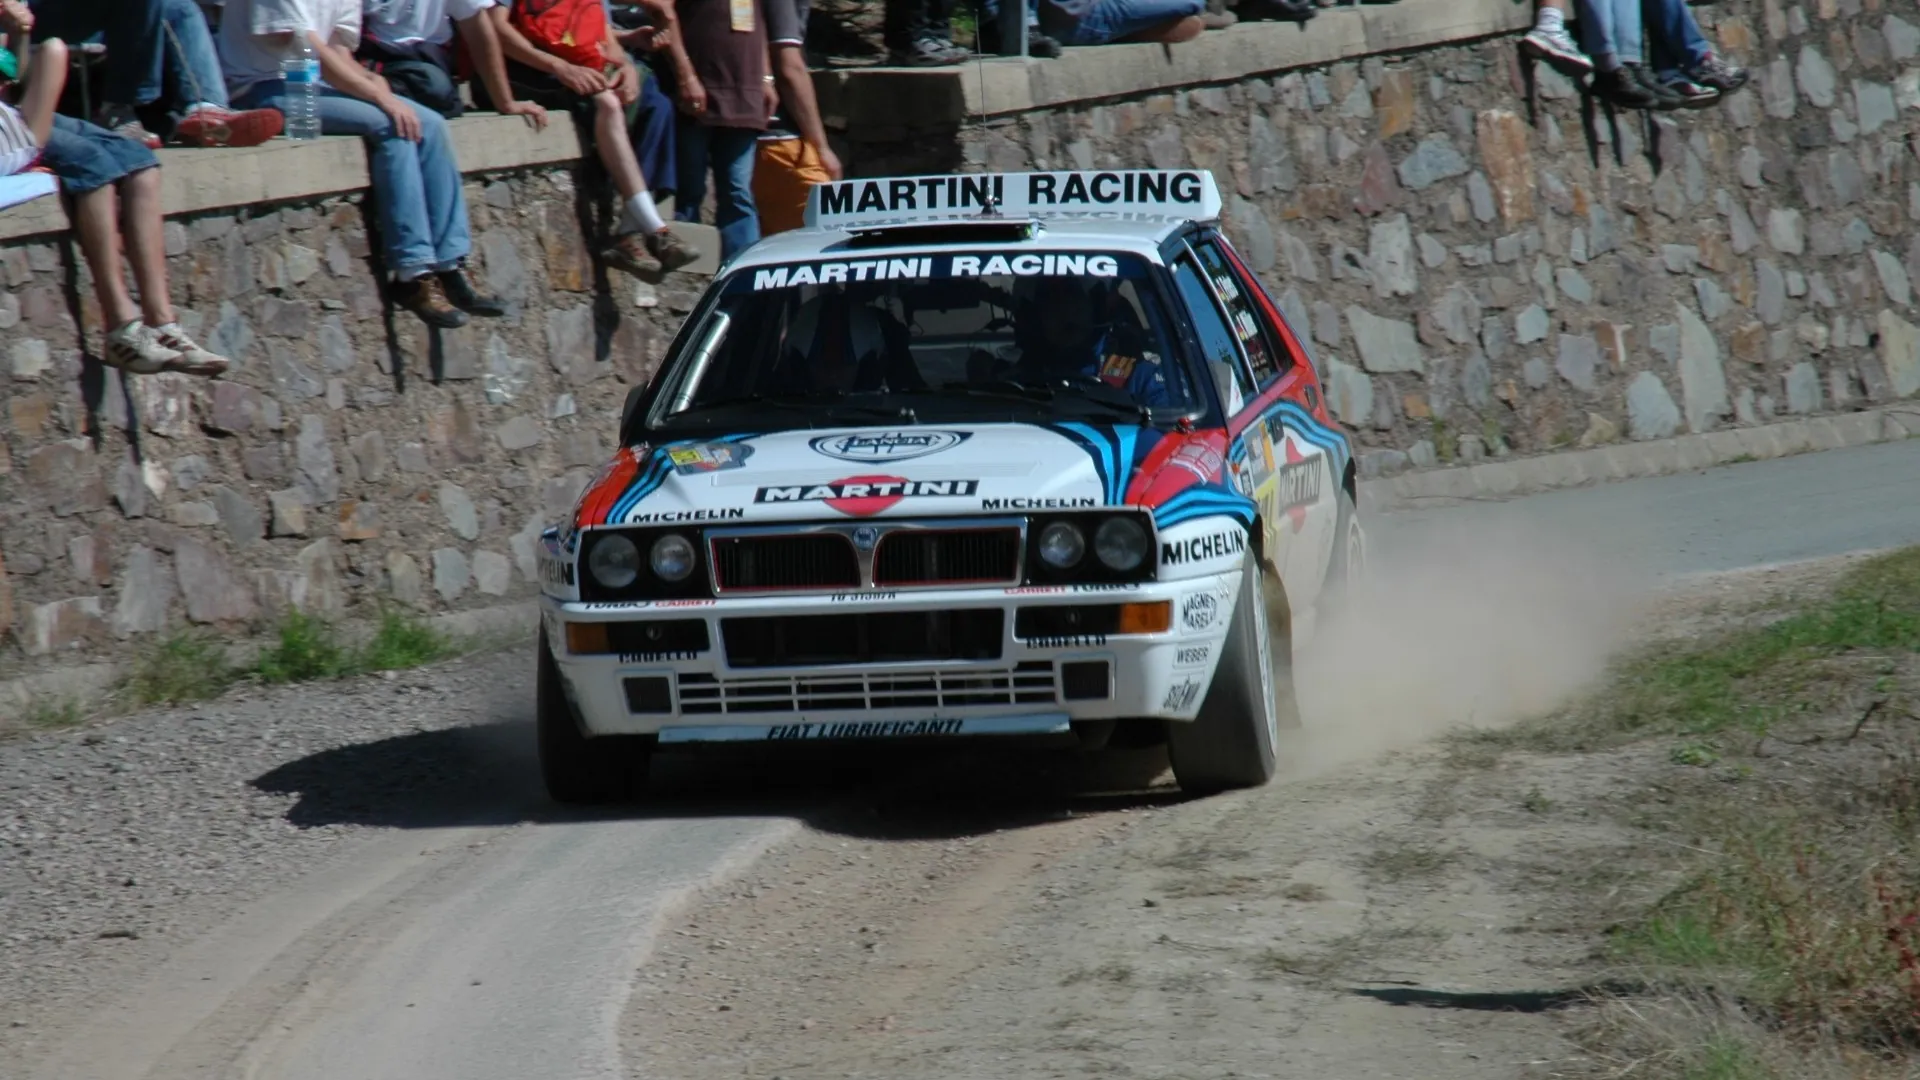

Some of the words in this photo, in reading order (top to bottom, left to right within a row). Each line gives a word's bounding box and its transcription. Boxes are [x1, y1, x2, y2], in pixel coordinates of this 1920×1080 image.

[820, 175, 1003, 215] MARTINI
[1028, 172, 1201, 204] RACING
[754, 257, 931, 291] MARTINI
[951, 255, 1118, 277] RACING
[764, 480, 968, 502] MARTINI
[981, 497, 1095, 510] MICHELIN
[632, 507, 744, 523] MICHELIN
[1161, 529, 1244, 565] MICHELIN
[1177, 646, 1209, 664] WEBER
[767, 724, 813, 741] FIAT
[818, 718, 963, 738] LUBRIFICANTI
